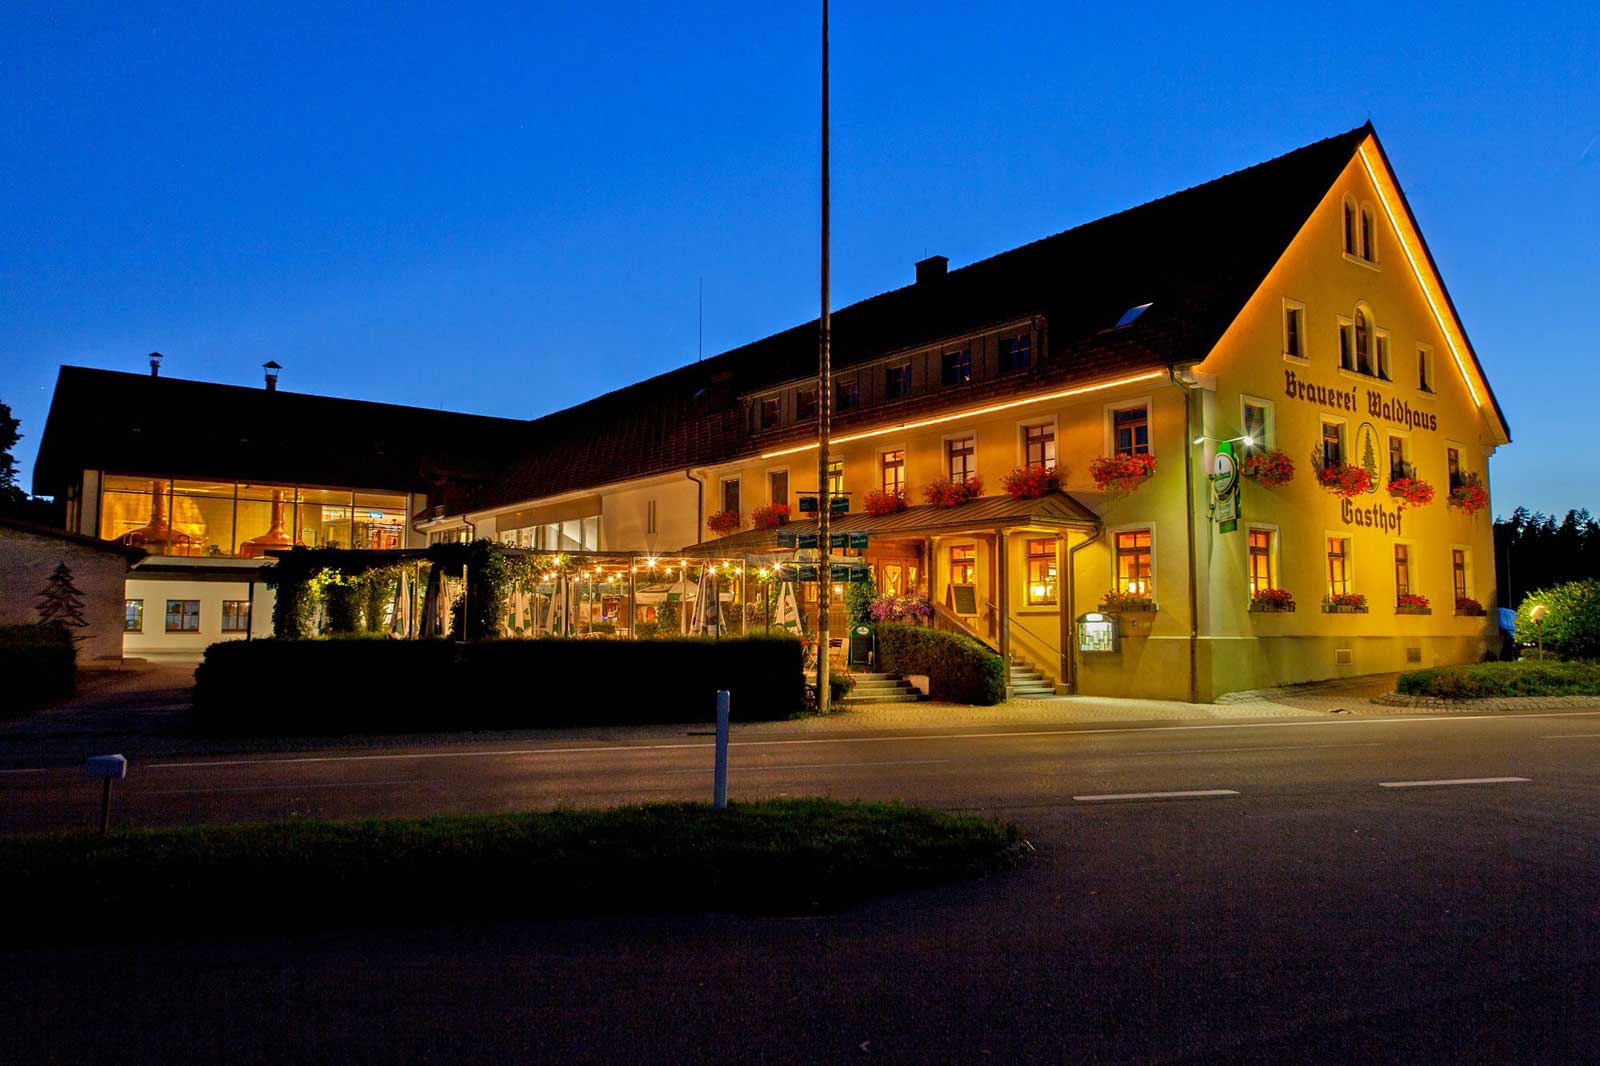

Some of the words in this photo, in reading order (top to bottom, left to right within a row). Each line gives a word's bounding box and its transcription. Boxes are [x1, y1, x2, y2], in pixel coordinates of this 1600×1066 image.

[1285, 369, 1357, 412] Brauerei
[1367, 390, 1437, 432] Waldhaus
[1341, 499, 1402, 536] Gasthof
